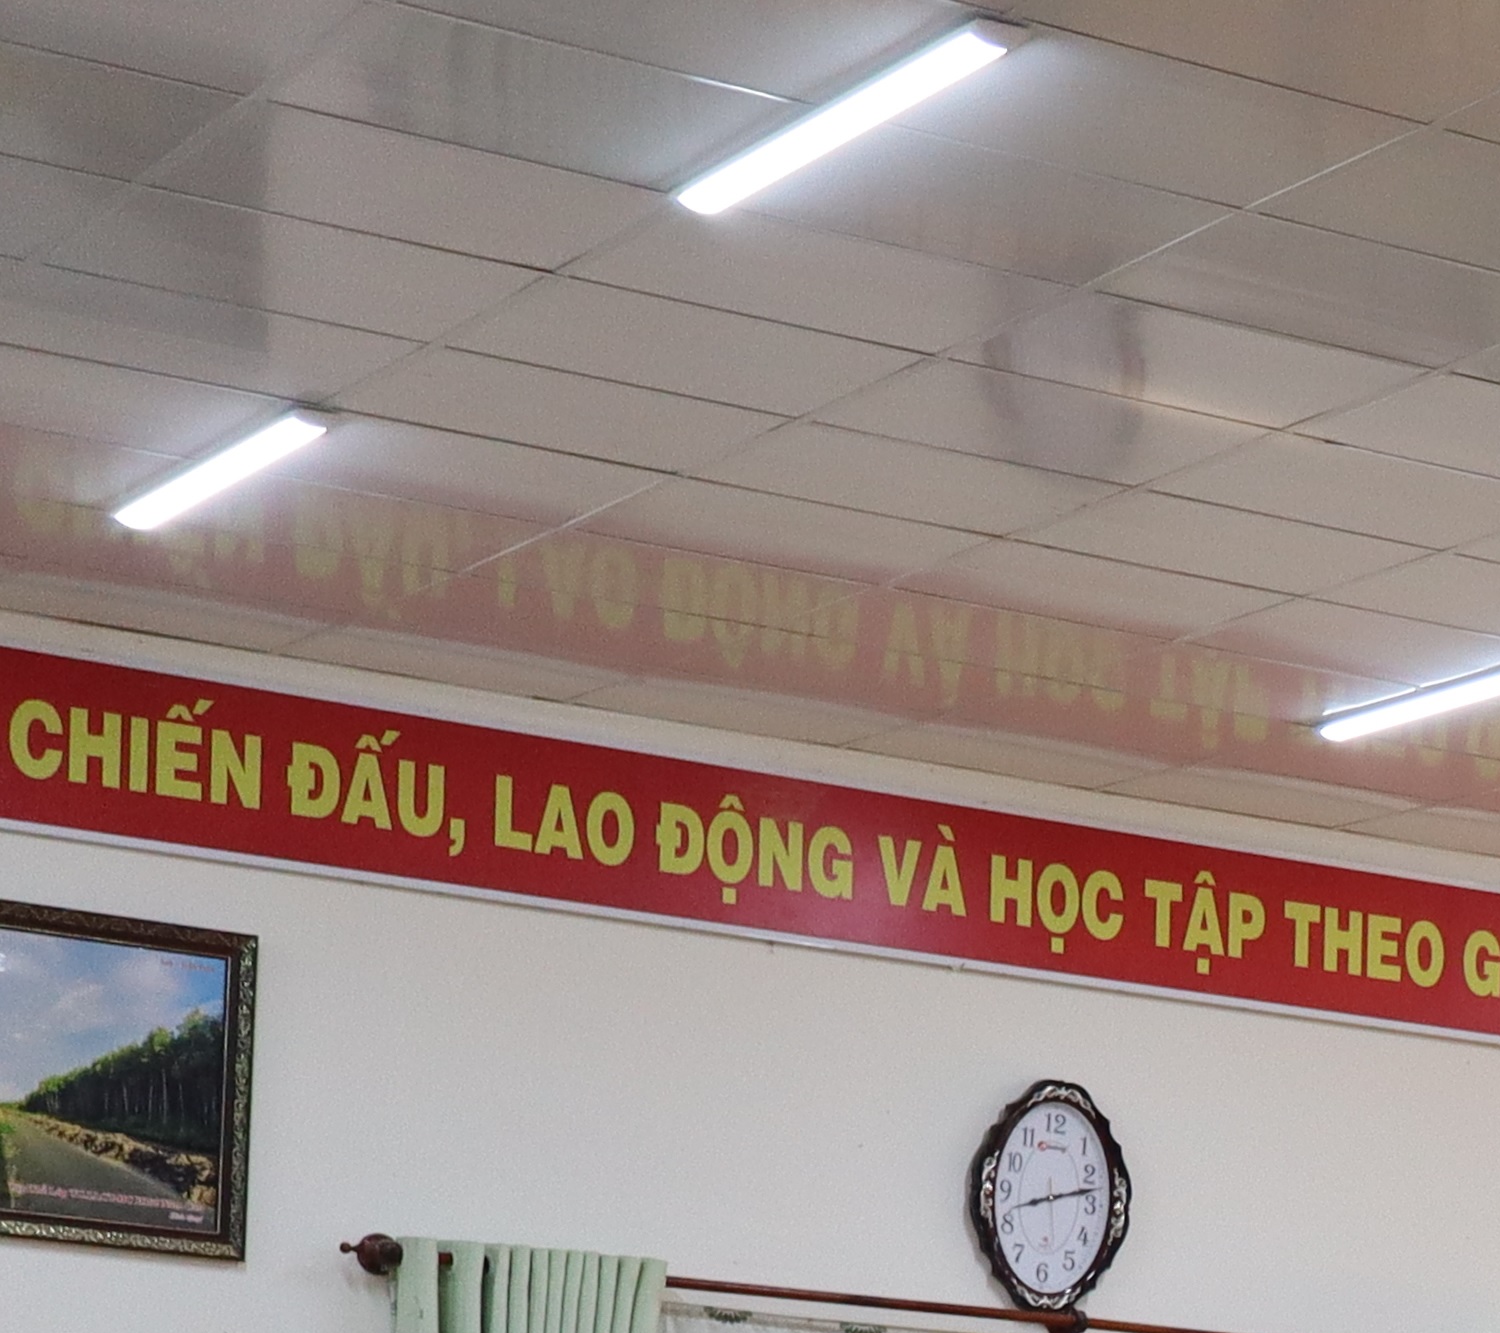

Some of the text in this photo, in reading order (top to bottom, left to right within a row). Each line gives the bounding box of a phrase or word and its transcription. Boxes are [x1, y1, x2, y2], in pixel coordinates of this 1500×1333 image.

[10, 700, 260, 807] CHIẾN
[288, 731, 464, 856] ĐẤU,
[495, 776, 634, 866] LAO
[656, 795, 852, 903] ĐỘNG
[880, 826, 965, 915] VÀ
[991, 855, 1123, 952] HỌC
[1145, 872, 1265, 973] TẬP
[1285, 902, 1444, 986] THEO
[1045, 1113, 1067, 1134] 12
[1022, 1127, 1035, 1148] 11
[1080, 1137, 1087, 1156] 1
[1008, 1152, 1023, 1173] 10
[1083, 1164, 1096, 1184] 2
[1000, 1180, 1012, 1200] 9
[1084, 1194, 1097, 1215] 3
[1001, 1214, 1014, 1235] 8
[1077, 1226, 1089, 1246] 4
[1012, 1243, 1025, 1263] 7
[1063, 1251, 1075, 1271] 5
[1036, 1262, 1048, 1283] 6
